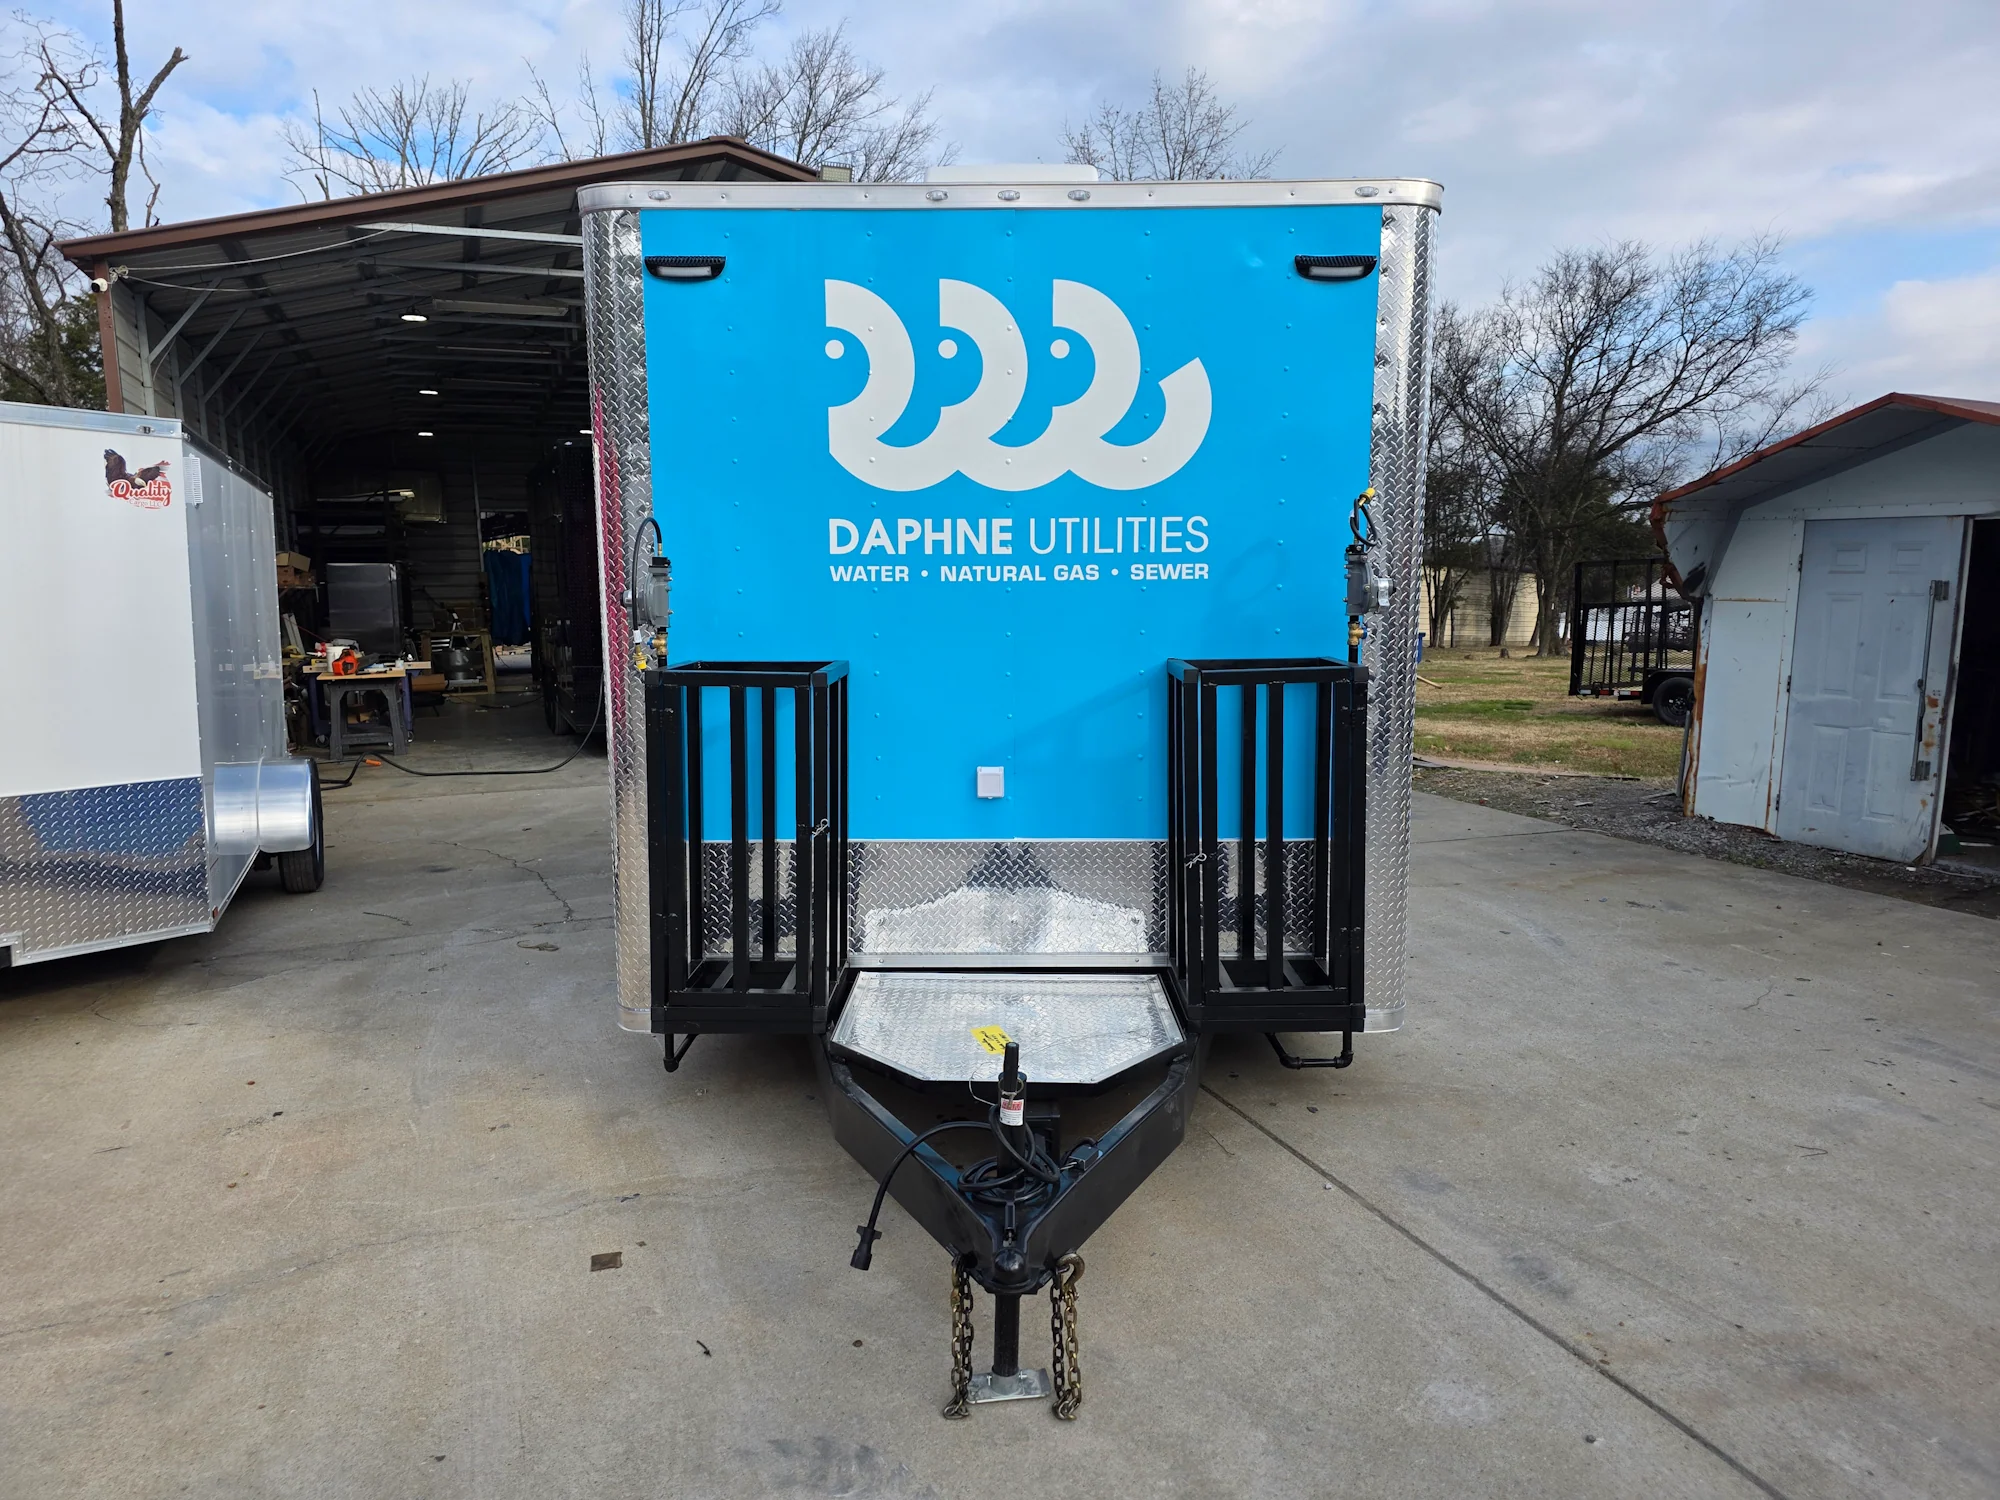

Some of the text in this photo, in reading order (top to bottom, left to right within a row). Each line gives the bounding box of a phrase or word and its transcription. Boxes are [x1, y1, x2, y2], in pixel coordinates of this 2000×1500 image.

[111, 480, 171, 506] Quality
[829, 516, 1209, 554] DAPHNE UTILITIES
[830, 563, 1209, 582] WATER NATURAL GAS SEWER
